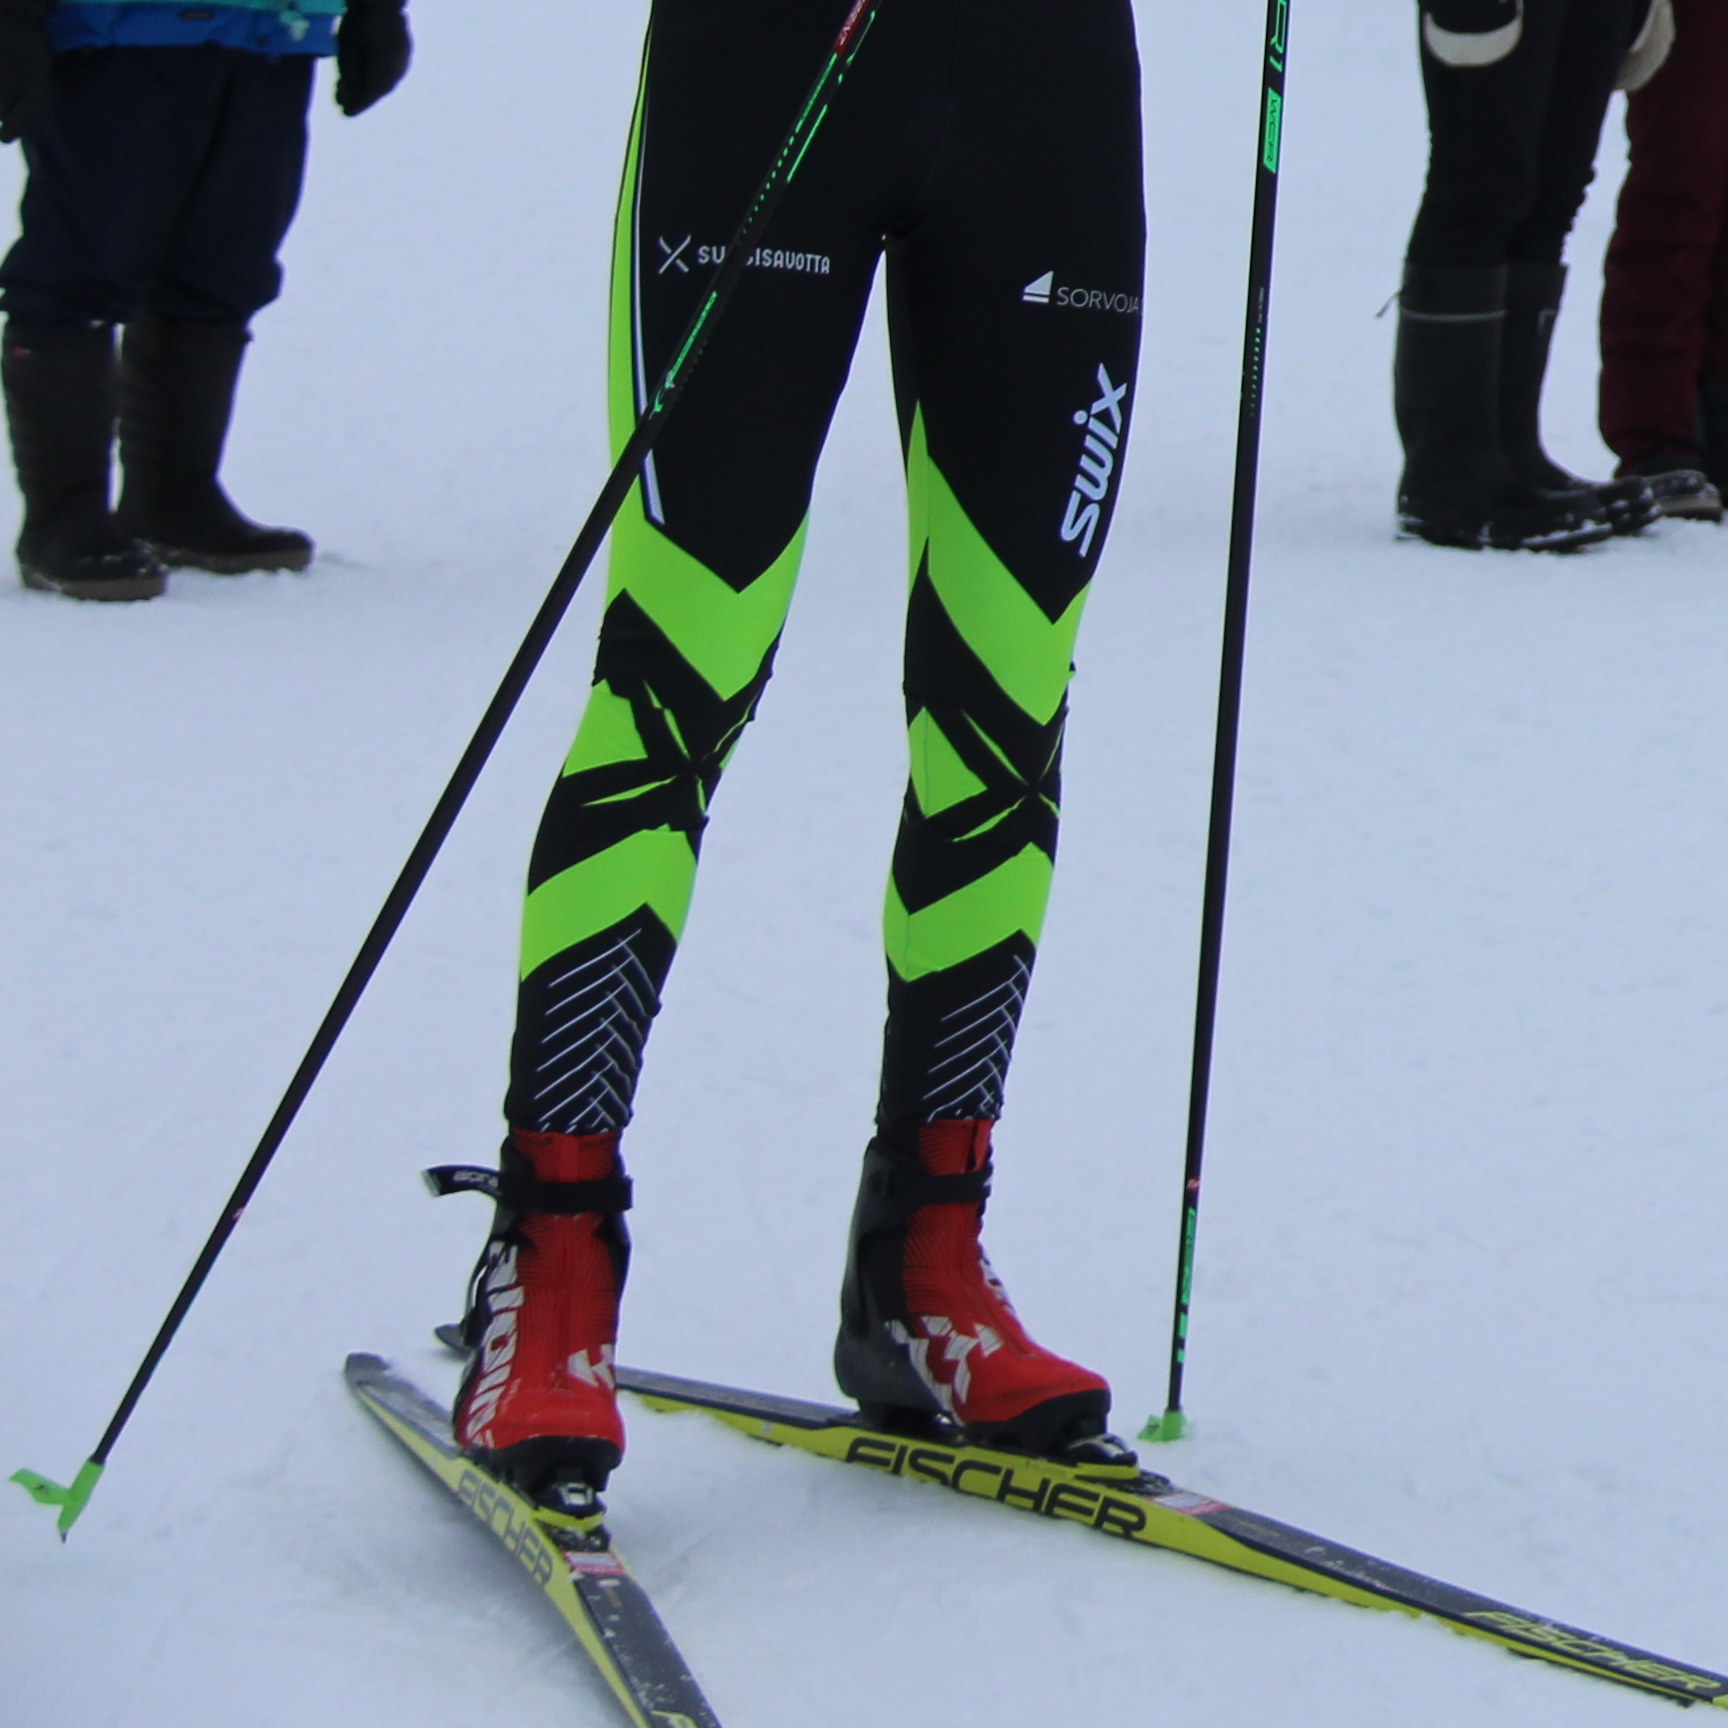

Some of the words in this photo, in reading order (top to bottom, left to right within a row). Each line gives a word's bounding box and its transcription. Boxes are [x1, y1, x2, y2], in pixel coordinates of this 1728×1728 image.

[697, 244, 831, 275] SUISAVOTTA
[455, 1470, 553, 1588] FISCHER
[846, 1435, 1147, 1541] FISCHER
